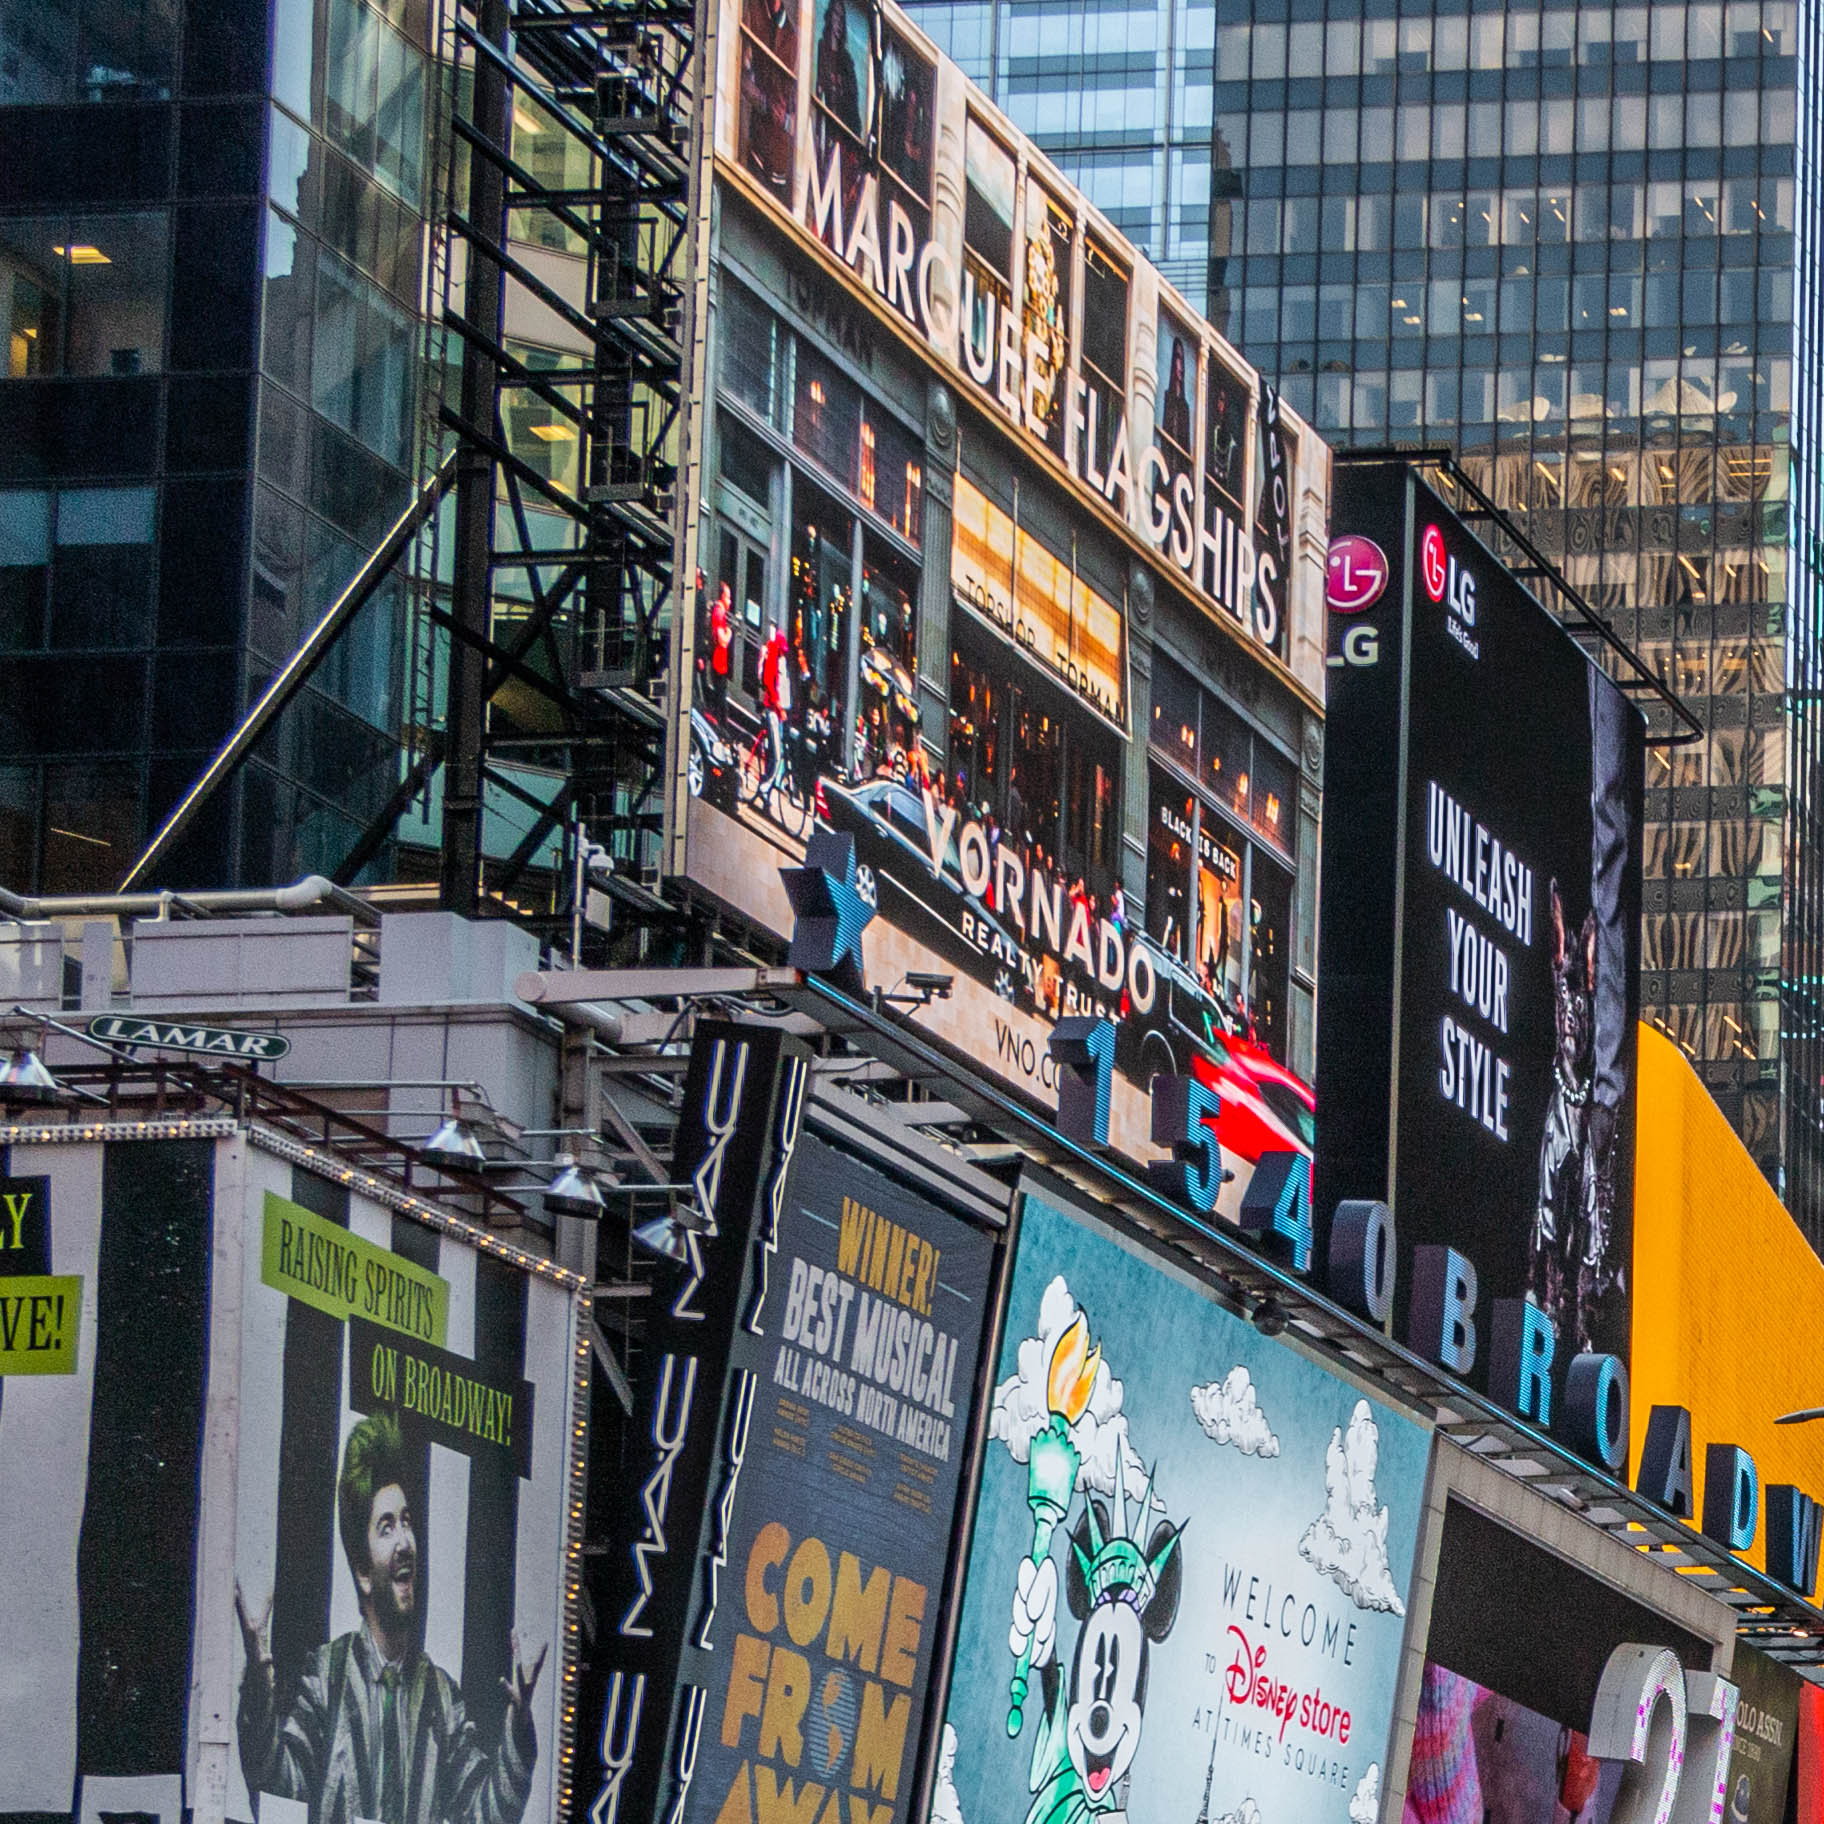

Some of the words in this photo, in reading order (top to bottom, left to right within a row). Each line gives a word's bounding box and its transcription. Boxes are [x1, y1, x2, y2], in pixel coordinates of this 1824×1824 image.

[802, 130, 1049, 442] MARQUEE
[1065, 369, 1278, 646] FLAGSHIPS
[965, 574, 1037, 651] TOPSHOP
[1446, 555, 1476, 627] LG
[1463, 630, 1479, 661] Good
[923, 788, 1156, 1014] VORNADO
[1161, 805, 1192, 843] BLACK
[1211, 842, 1237, 880] BACK
[1429, 780, 1533, 947] UNLEASH
[961, 911, 1043, 985] REALTY
[1447, 906, 1509, 1034] YOUR
[1439, 1014, 1509, 1143] STYLE
[1055, 1017, 1397, 1321] 1540
[279, 1217, 357, 1313] RAISING
[365, 1257, 434, 1341] SPIRITS
[838, 1196, 941, 1317] WINNER!
[371, 1342, 398, 1402] ON
[403, 1357, 514, 1447] BROADWAY!
[782, 1257, 855, 1364] BEST
[850, 1291, 959, 1419] MUSICAL
[773, 1345, 801, 1393] ALL
[801, 1357, 857, 1417] ACROSS
[855, 1382, 899, 1437] NORTH
[895, 1403, 951, 1463] AMERICA
[743, 1519, 929, 1684] COME
[1222, 1562, 1359, 1668] WELCOME
[1204, 1652, 1217, 1674] TO
[1301, 1690, 1352, 1747] store
[1222, 1716, 1273, 1761] TIMES
[1283, 1742, 1350, 1791] SQUARE
